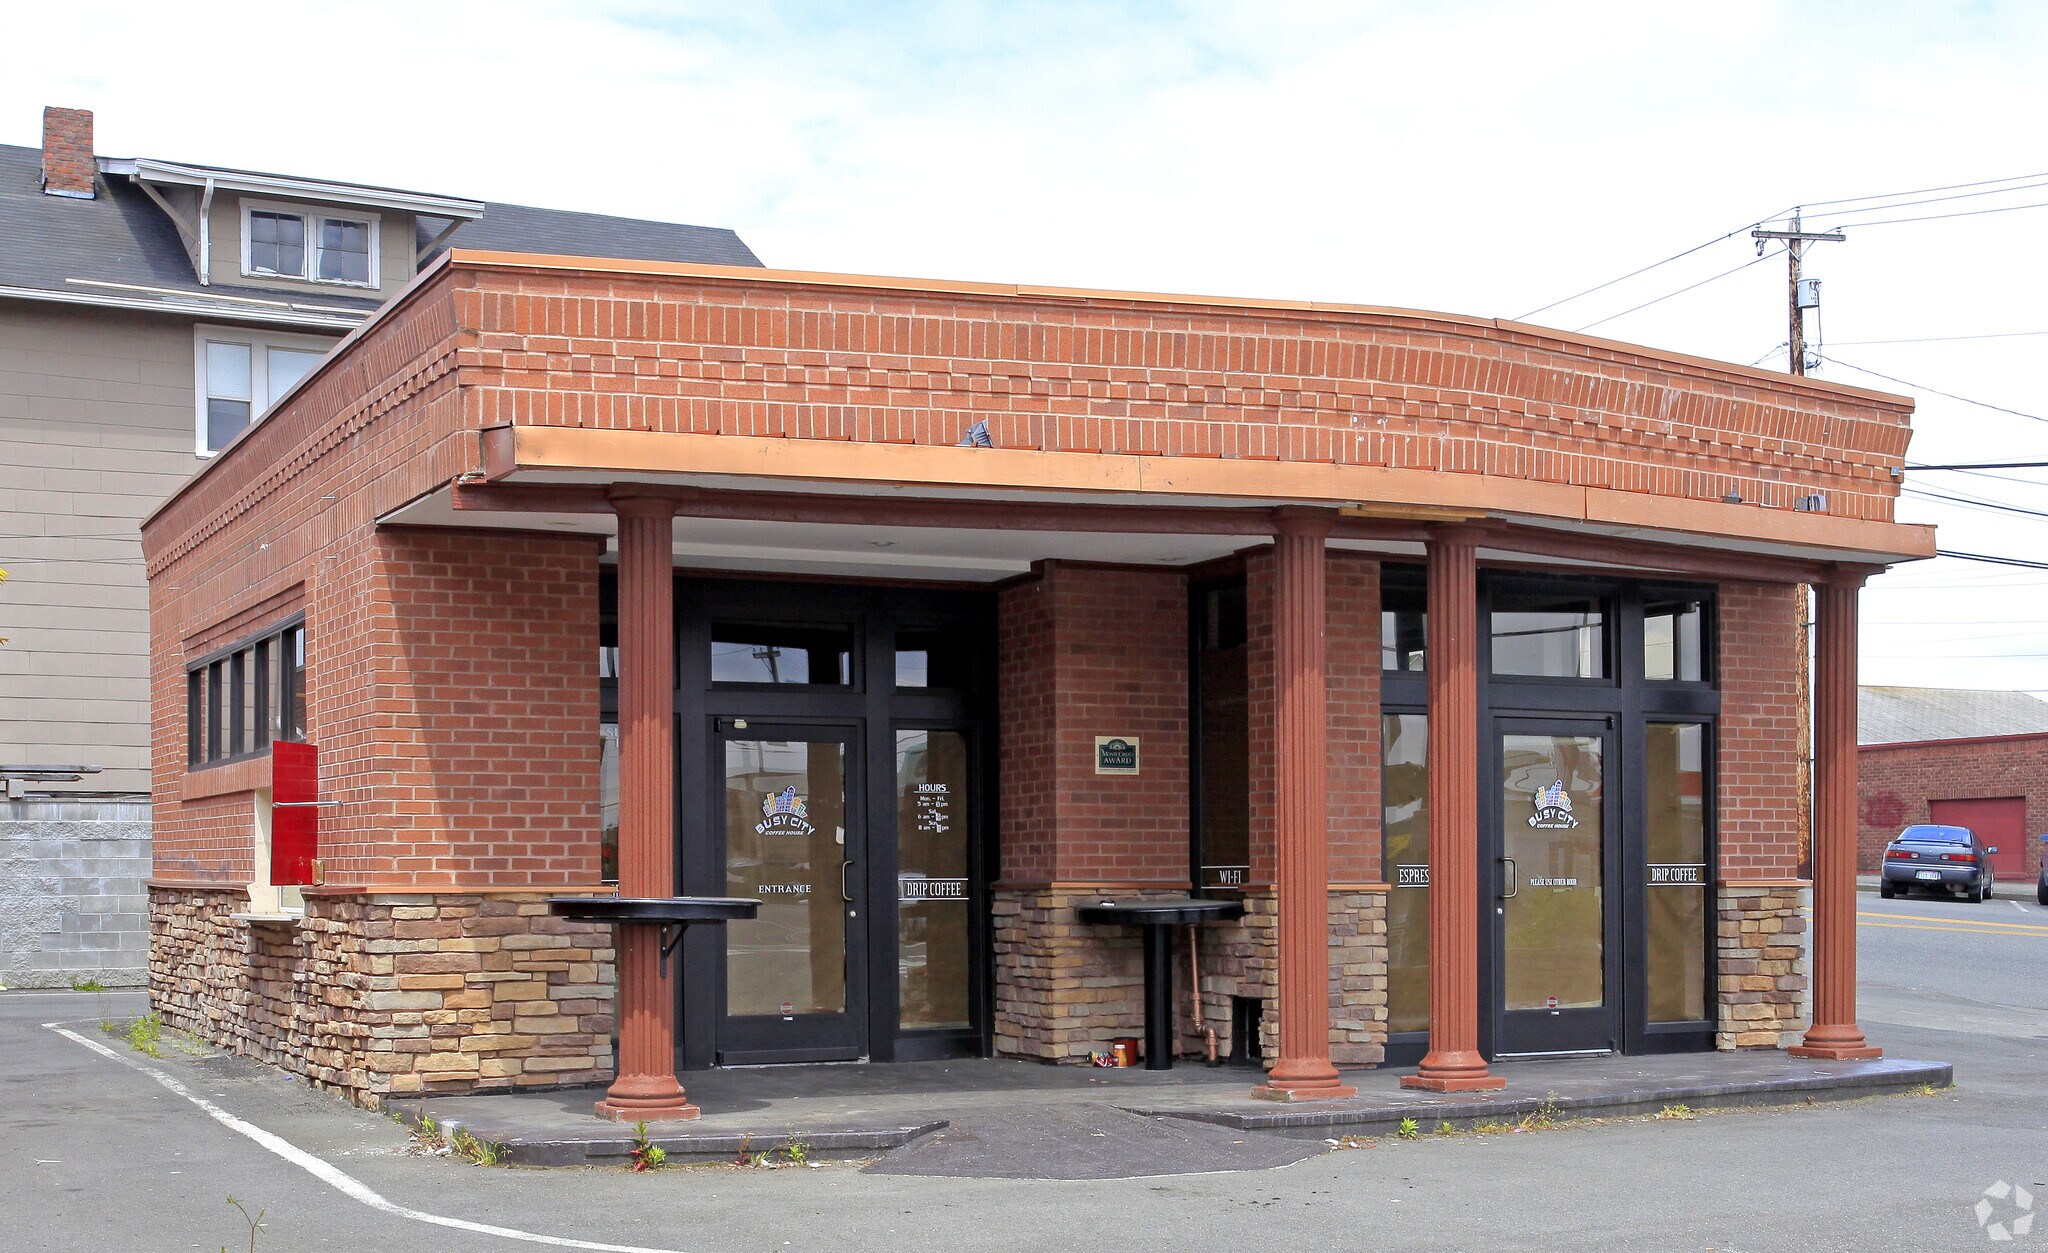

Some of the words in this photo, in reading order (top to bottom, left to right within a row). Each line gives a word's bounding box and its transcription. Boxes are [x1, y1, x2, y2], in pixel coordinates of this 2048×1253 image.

[918, 783, 947, 792] HOURS
[755, 815, 787, 834] BUSY
[790, 817, 816, 836] CITY
[1528, 808, 1556, 827] BUSY
[1558, 810, 1579, 829] CITY
[1651, 867, 1669, 882] DRIP
[1670, 867, 1698, 882] COFFEE
[758, 884, 811, 894] ENTRANCE
[907, 882, 928, 896] DRIP
[929, 882, 962, 896] COFFEE
[1530, 878, 1544, 886] PLEASE
